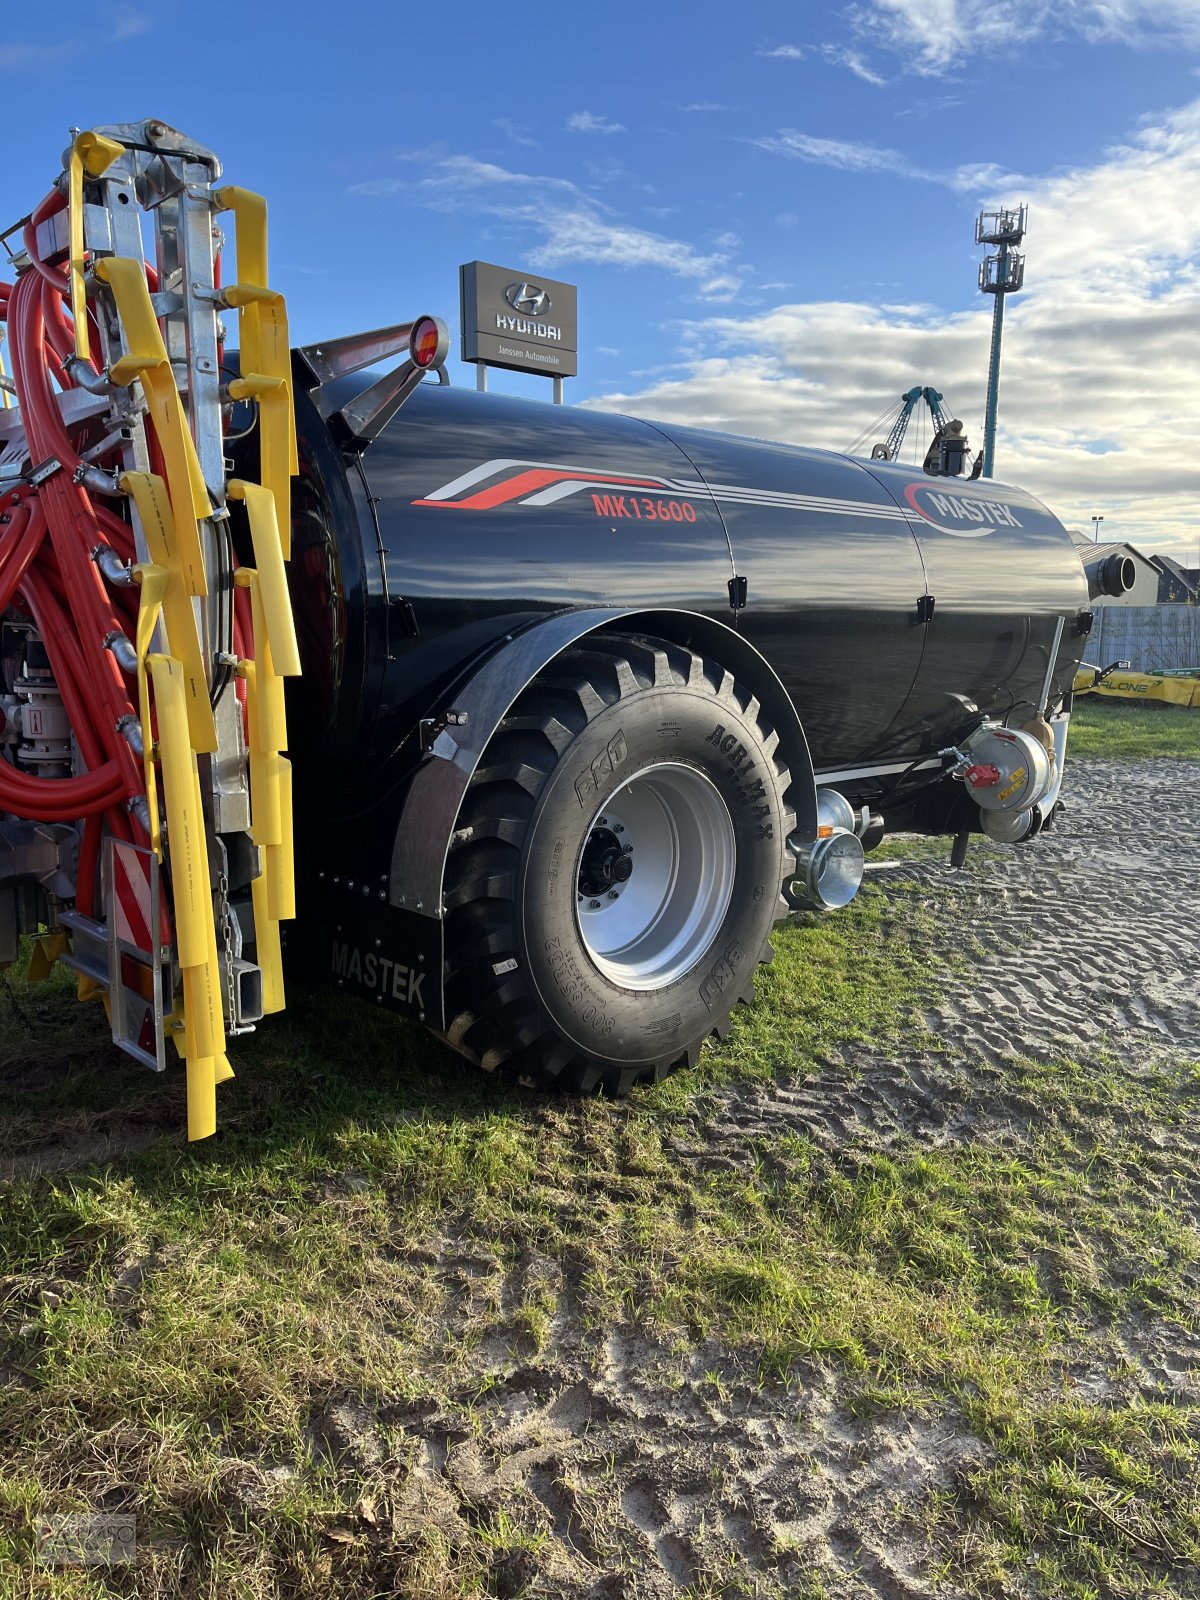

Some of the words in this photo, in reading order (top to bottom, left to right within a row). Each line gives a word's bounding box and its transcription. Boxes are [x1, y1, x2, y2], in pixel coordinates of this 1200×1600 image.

[496, 314, 561, 341] HYUNDAI
[498, 345, 524, 359] Janssen
[525, 350, 560, 365] Automobile
[591, 494, 696, 522] MK13600
[926, 492, 1024, 528] MASTEK
[1099, 680, 1149, 692] ALONE
[705, 723, 755, 778] AGRI
[746, 777, 774, 841] MAX
[331, 940, 426, 1009] MASTEK
